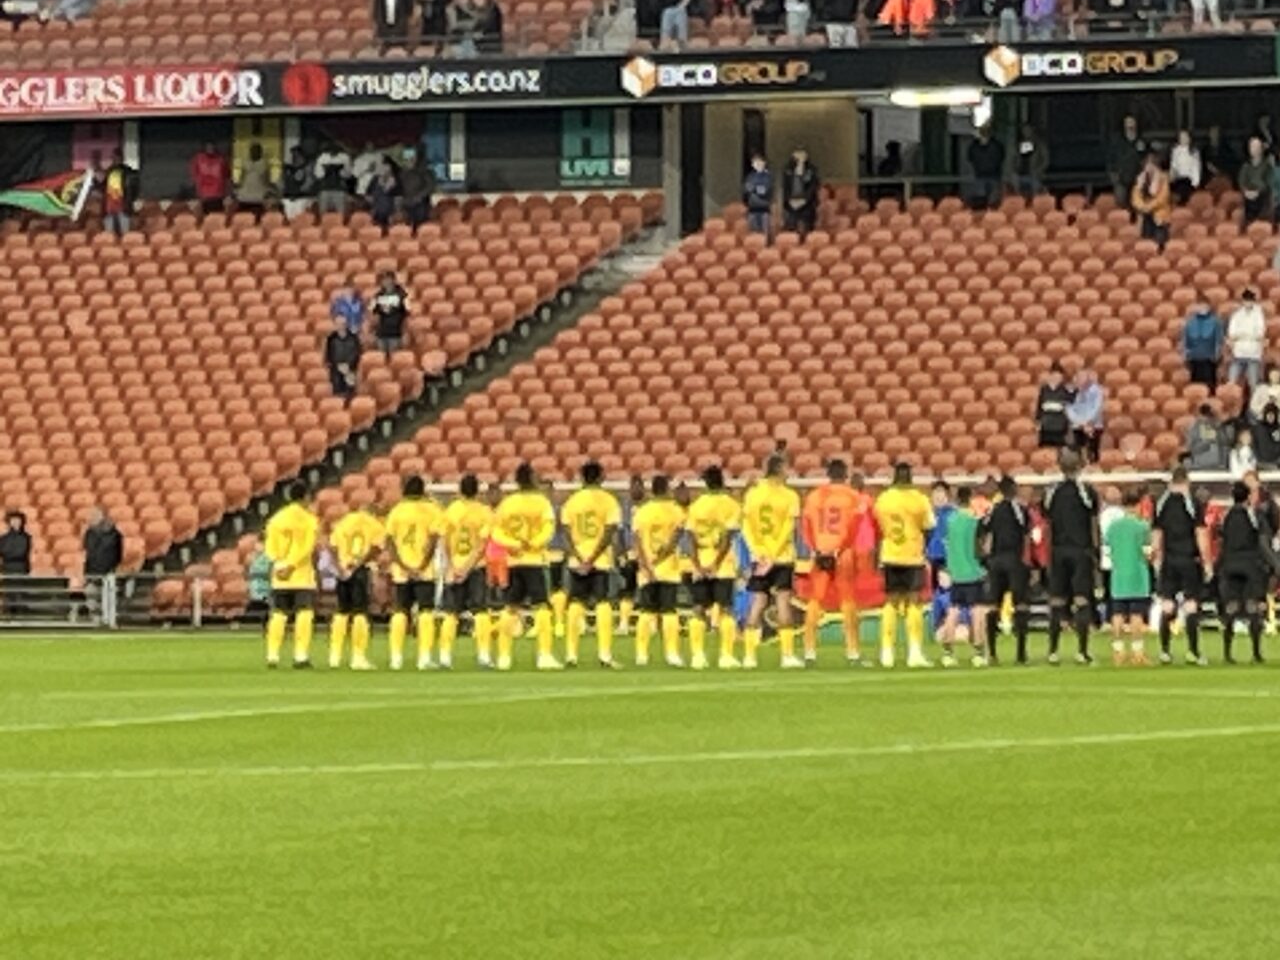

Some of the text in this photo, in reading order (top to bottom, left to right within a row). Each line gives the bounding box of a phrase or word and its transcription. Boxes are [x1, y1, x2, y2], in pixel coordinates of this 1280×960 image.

[134, 69, 263, 106] LIQUOR
[759, 505, 774, 535] 5
[818, 506, 841, 535] 12
[890, 514, 906, 545] 3
[402, 523, 416, 551] 4
